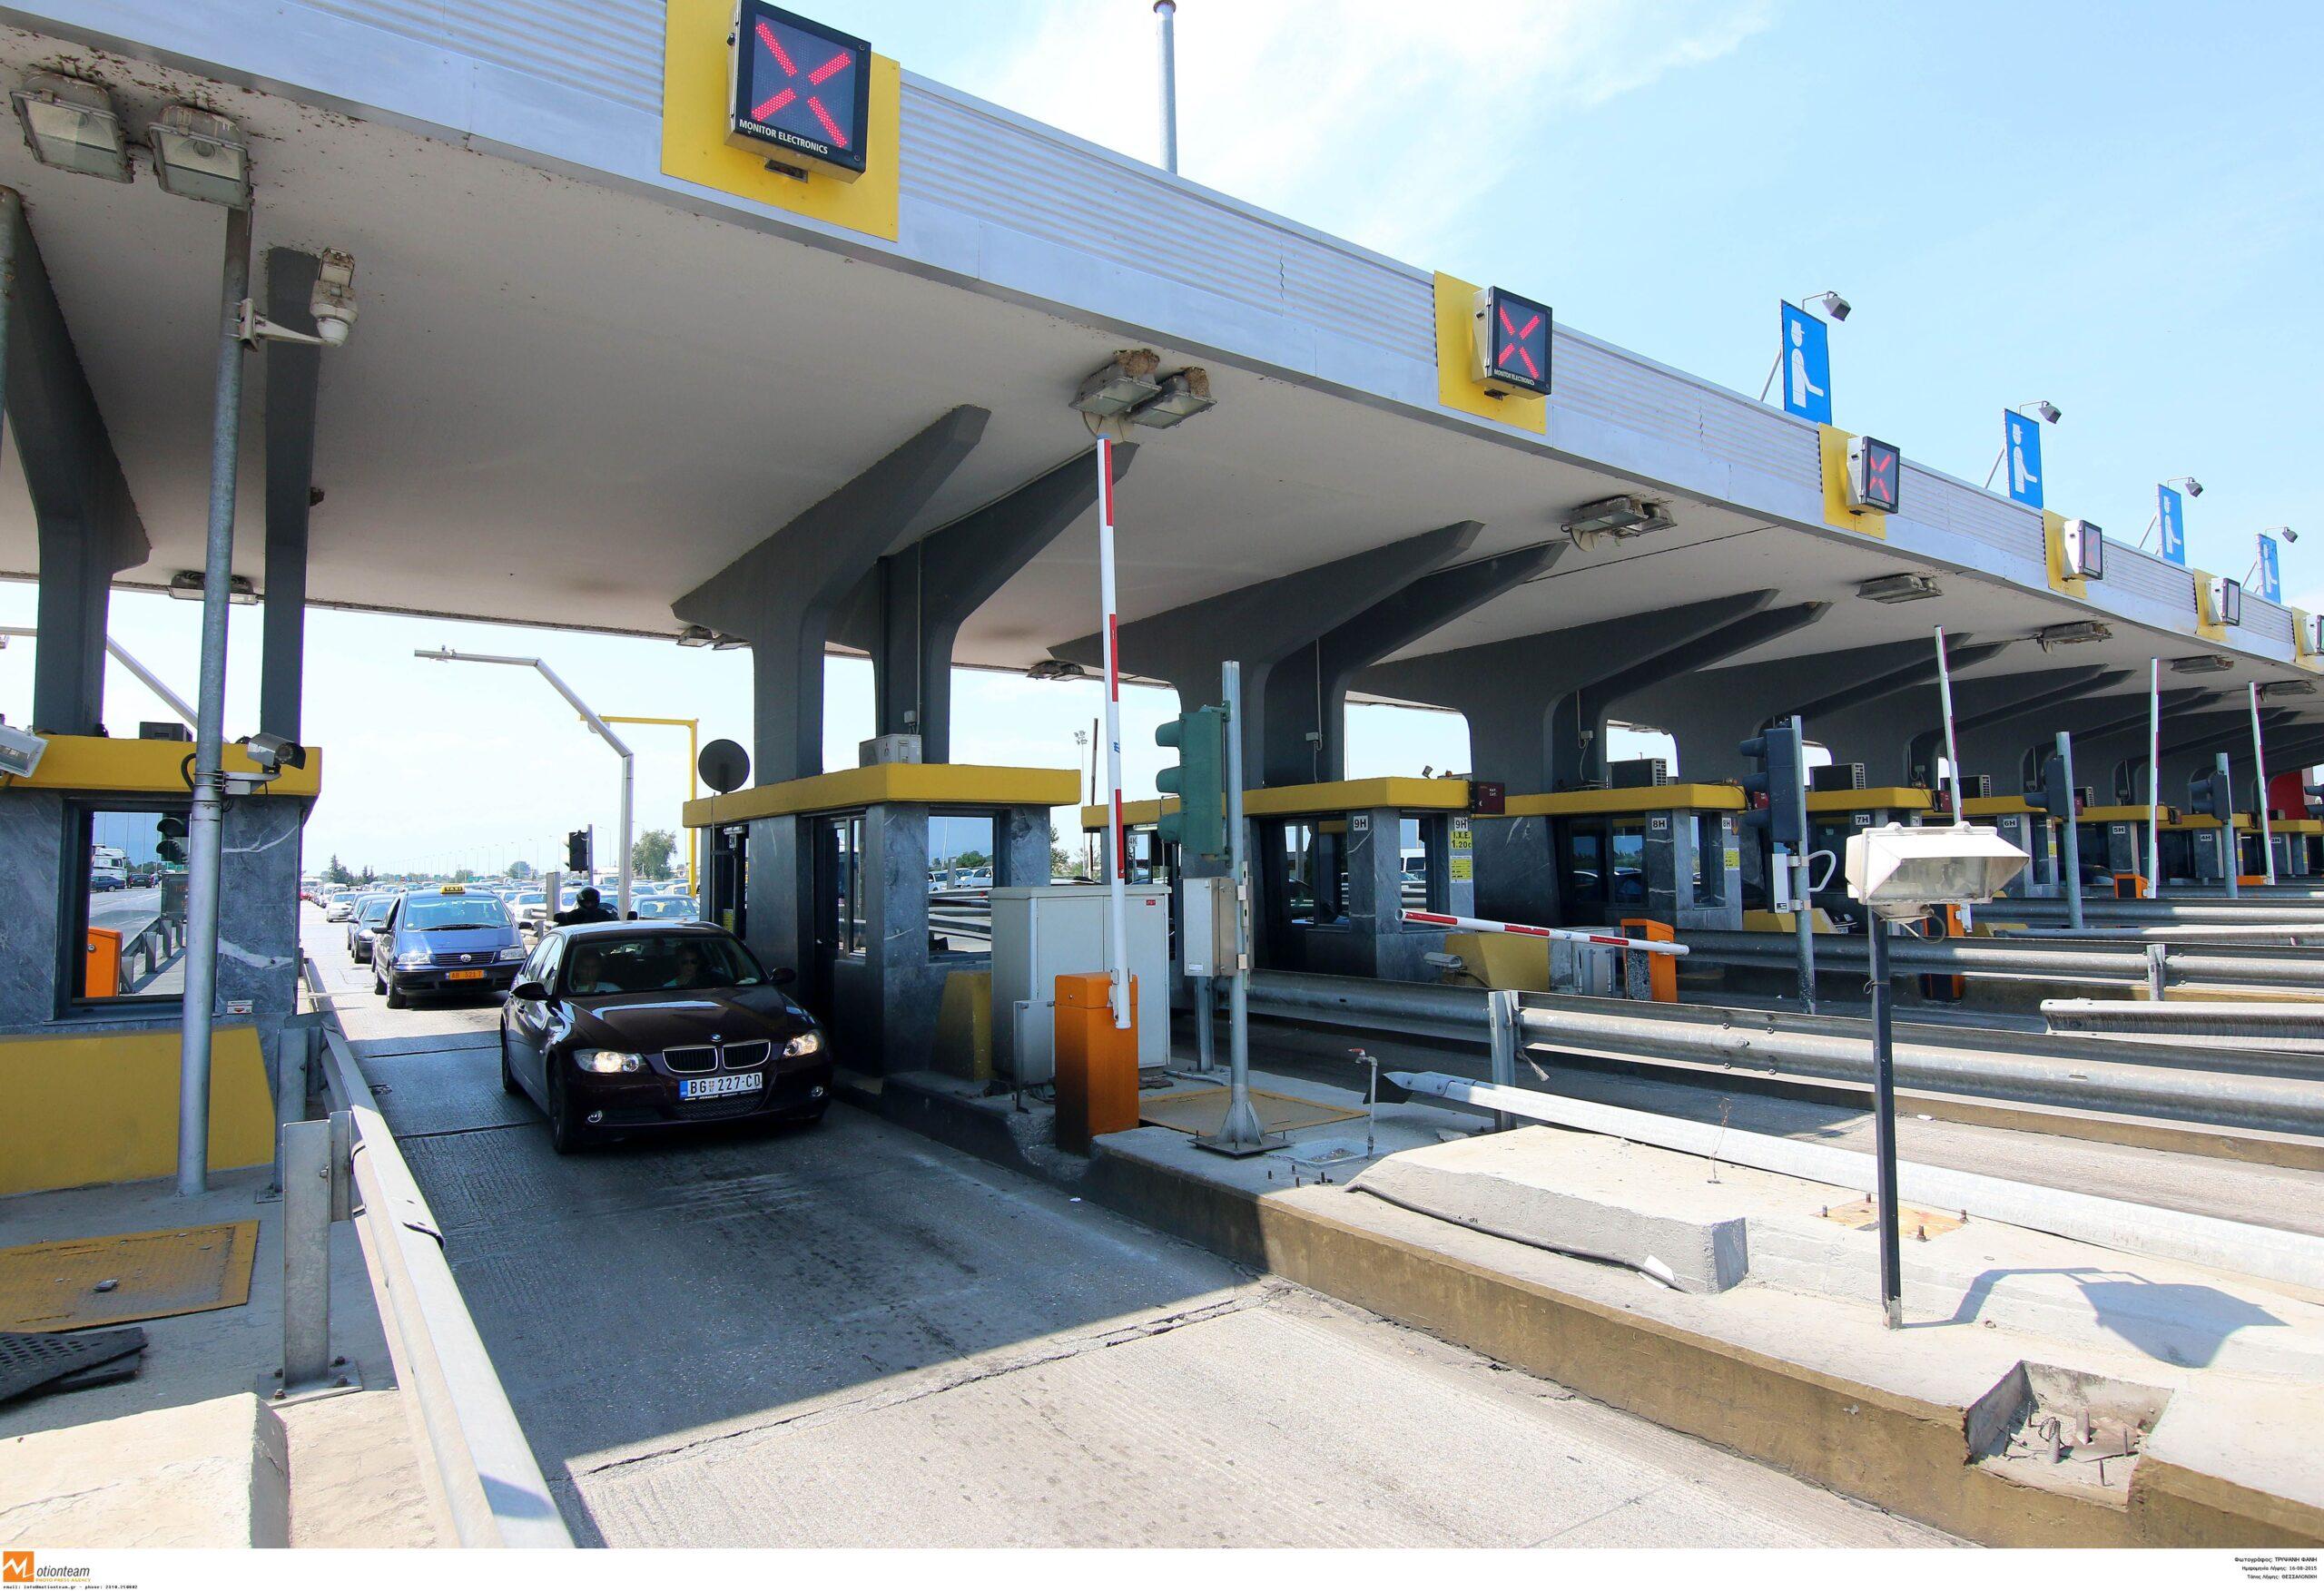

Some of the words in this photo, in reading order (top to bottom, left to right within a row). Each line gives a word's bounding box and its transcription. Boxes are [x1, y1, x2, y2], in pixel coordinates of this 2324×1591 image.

[739, 118, 777, 139] MONITOR
[778, 131, 829, 154] ELECTRONICS
[1354, 819, 1366, 828] 9H
[1455, 820, 1467, 829] 9H
[1856, 816, 1869, 824] 7H
[690, 1081, 706, 1094] BG
